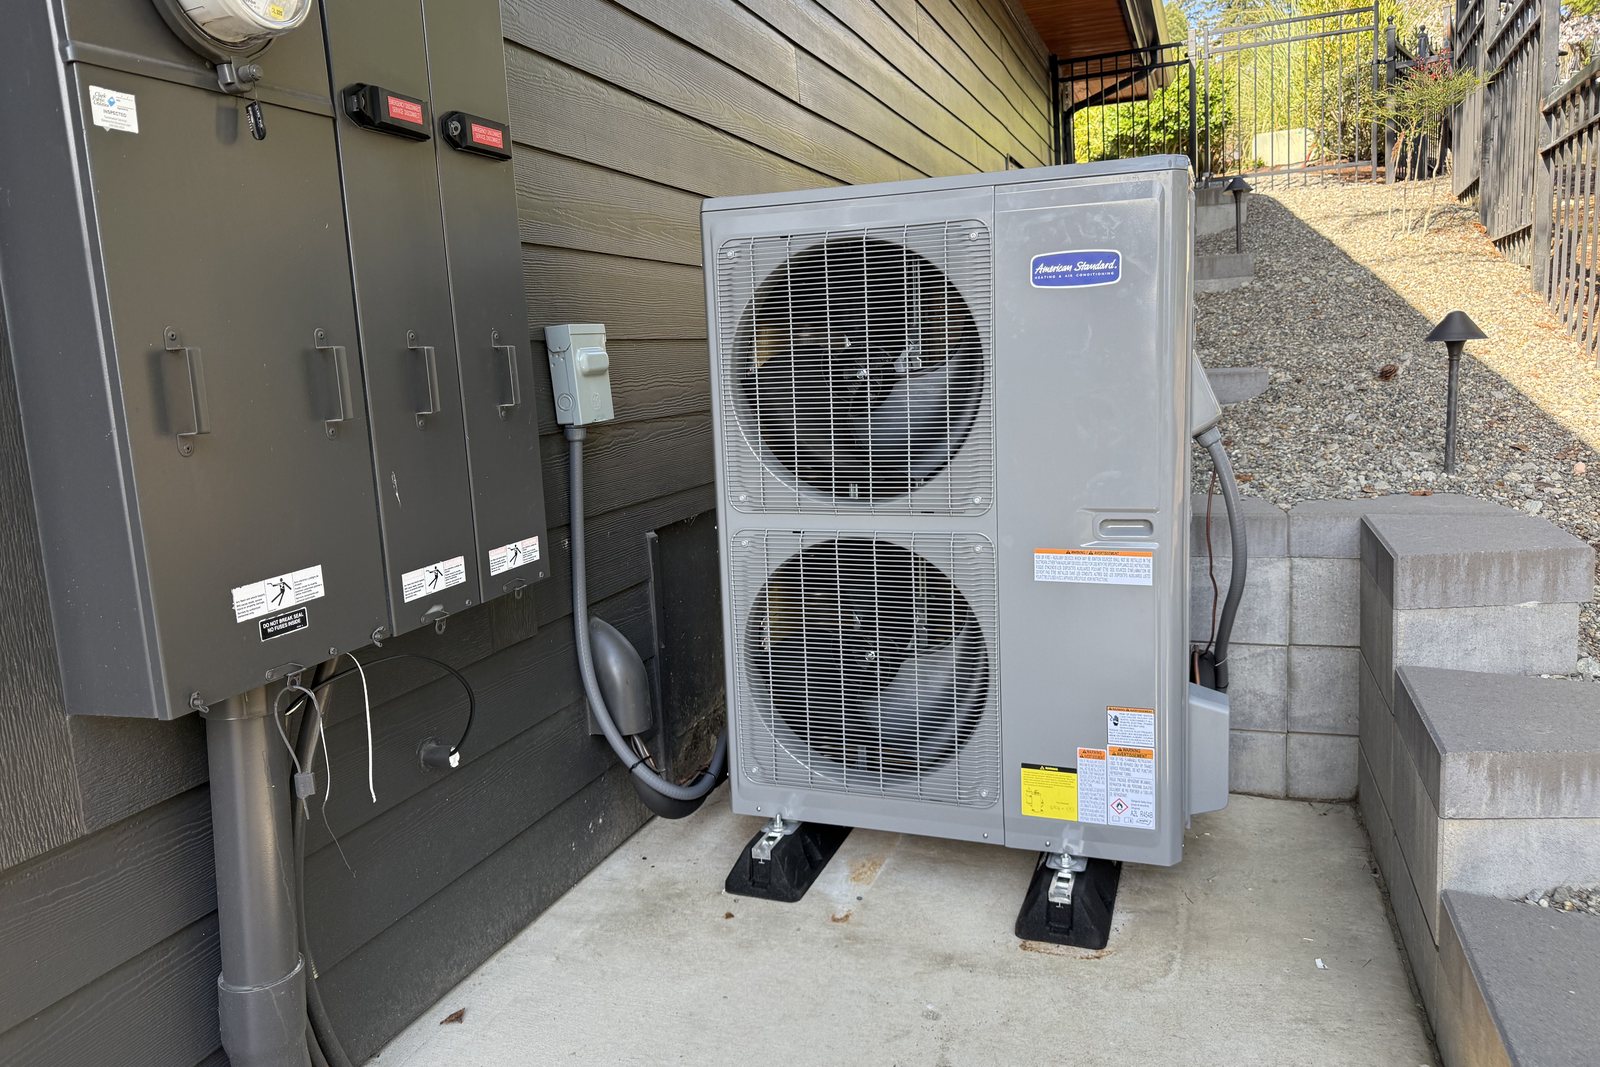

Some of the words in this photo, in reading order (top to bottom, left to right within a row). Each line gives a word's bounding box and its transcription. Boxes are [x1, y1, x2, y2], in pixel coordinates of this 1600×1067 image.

[1034, 263, 1073, 274] American
[279, 615, 293, 623] BREAK
[293, 611, 304, 620] SEAL
[274, 622, 288, 631] FUSES
[288, 618, 301, 627] INSIDE
